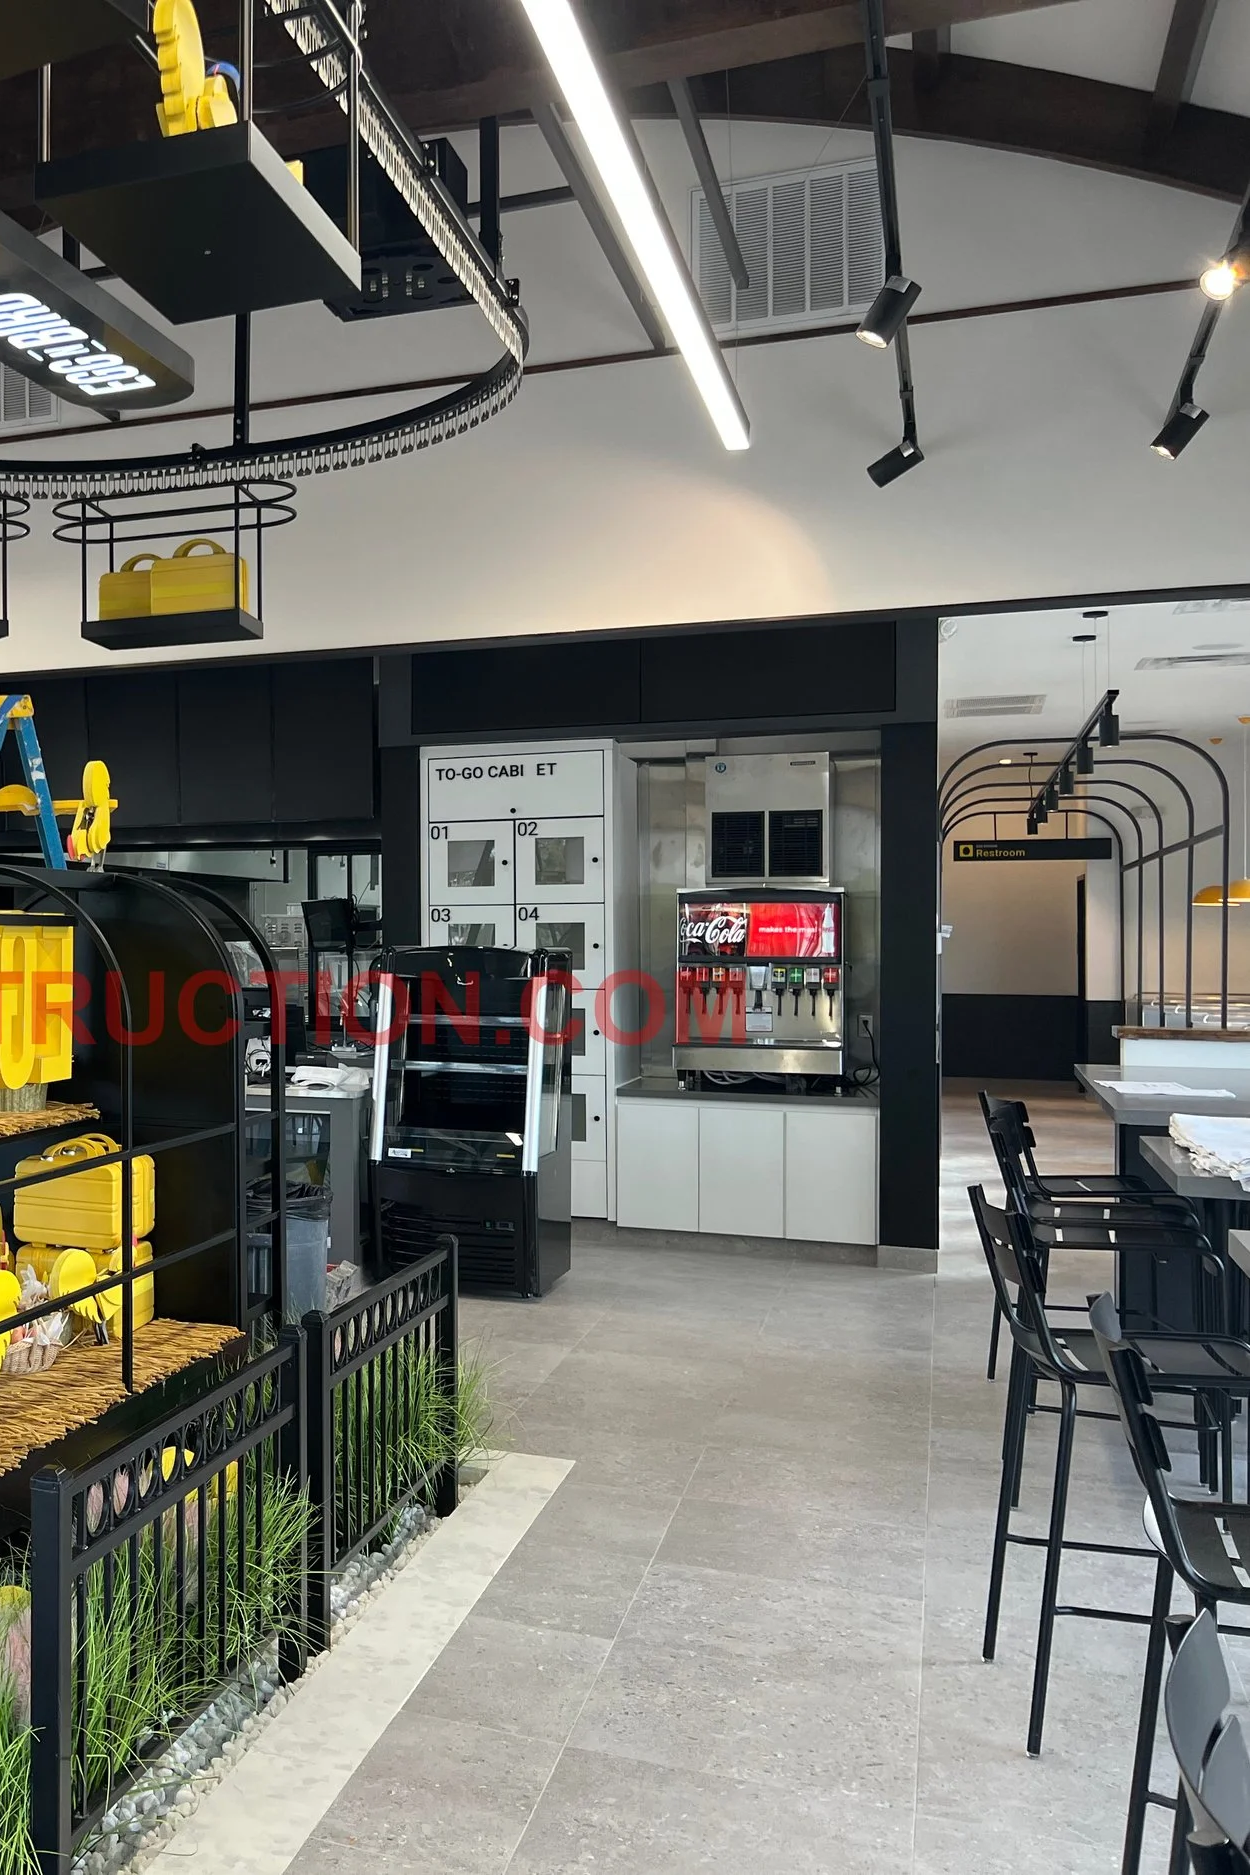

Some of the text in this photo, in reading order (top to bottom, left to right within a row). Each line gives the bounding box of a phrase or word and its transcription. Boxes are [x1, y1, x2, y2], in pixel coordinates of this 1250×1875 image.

[48, 353, 157, 396] EGG
[435, 766, 484, 781] TO-GO
[430, 825, 449, 840] 01
[517, 821, 539, 837] 02
[976, 848, 1026, 857] Restroom
[431, 908, 451, 923] 03
[518, 906, 540, 921] 04
[680, 915, 748, 944] Coca-Cola
[758, 925, 783, 933] makes
[784, 925, 797, 933] the
